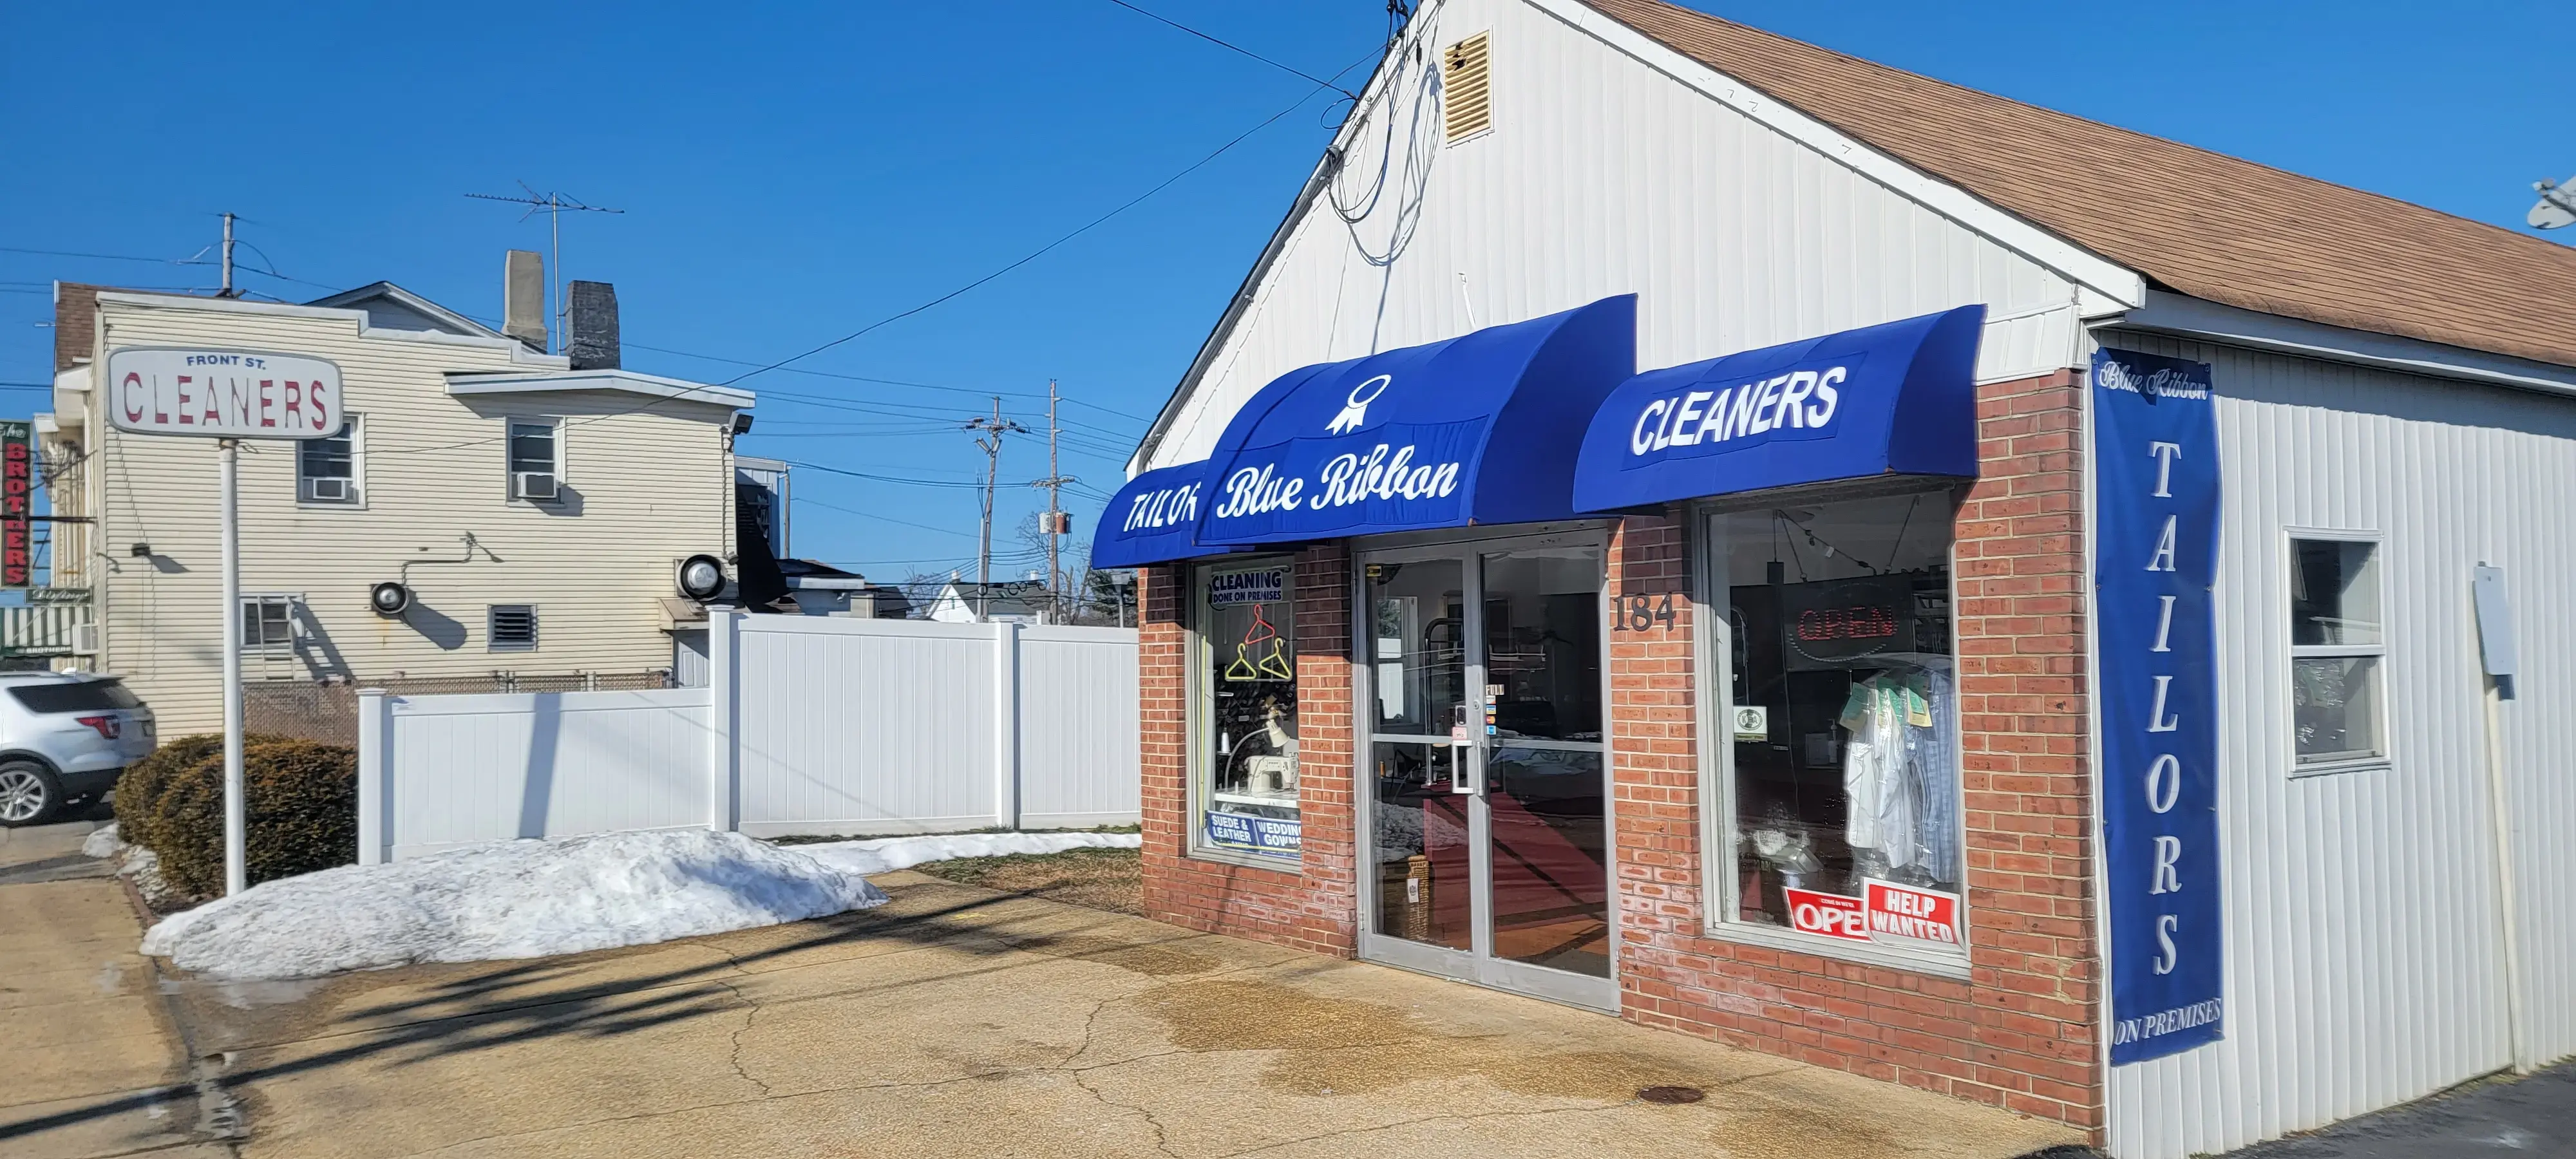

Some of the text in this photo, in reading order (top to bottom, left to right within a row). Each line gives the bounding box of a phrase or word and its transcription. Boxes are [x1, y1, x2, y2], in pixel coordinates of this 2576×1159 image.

[187, 355, 267, 370] FRONT ST.
[2099, 361, 2209, 400] Blue Ribbon
[123, 371, 327, 431] CLEANERS
[1631, 366, 1847, 456] CLEANERS
[1217, 443, 1459, 518] Blue Ribbon
[5, 443, 27, 583] BROTHERS
[1212, 571, 1282, 591] CLEANING
[1213, 590, 1282, 603] DONE ON PREMISES
[1613, 592, 1676, 632] 184
[1797, 605, 1895, 641] OPEN
[2143, 440, 2183, 976] TAILORS
[1211, 815, 1249, 831] SUEDE &
[1212, 826, 1251, 843] LEATHER
[1256, 821, 1301, 836] WEDDIN
[1796, 903, 1866, 937] OPE
[1886, 889, 1936, 919] HELP
[1871, 909, 1954, 943] WANTED
[2114, 997, 2221, 1046] ON PREMISES
